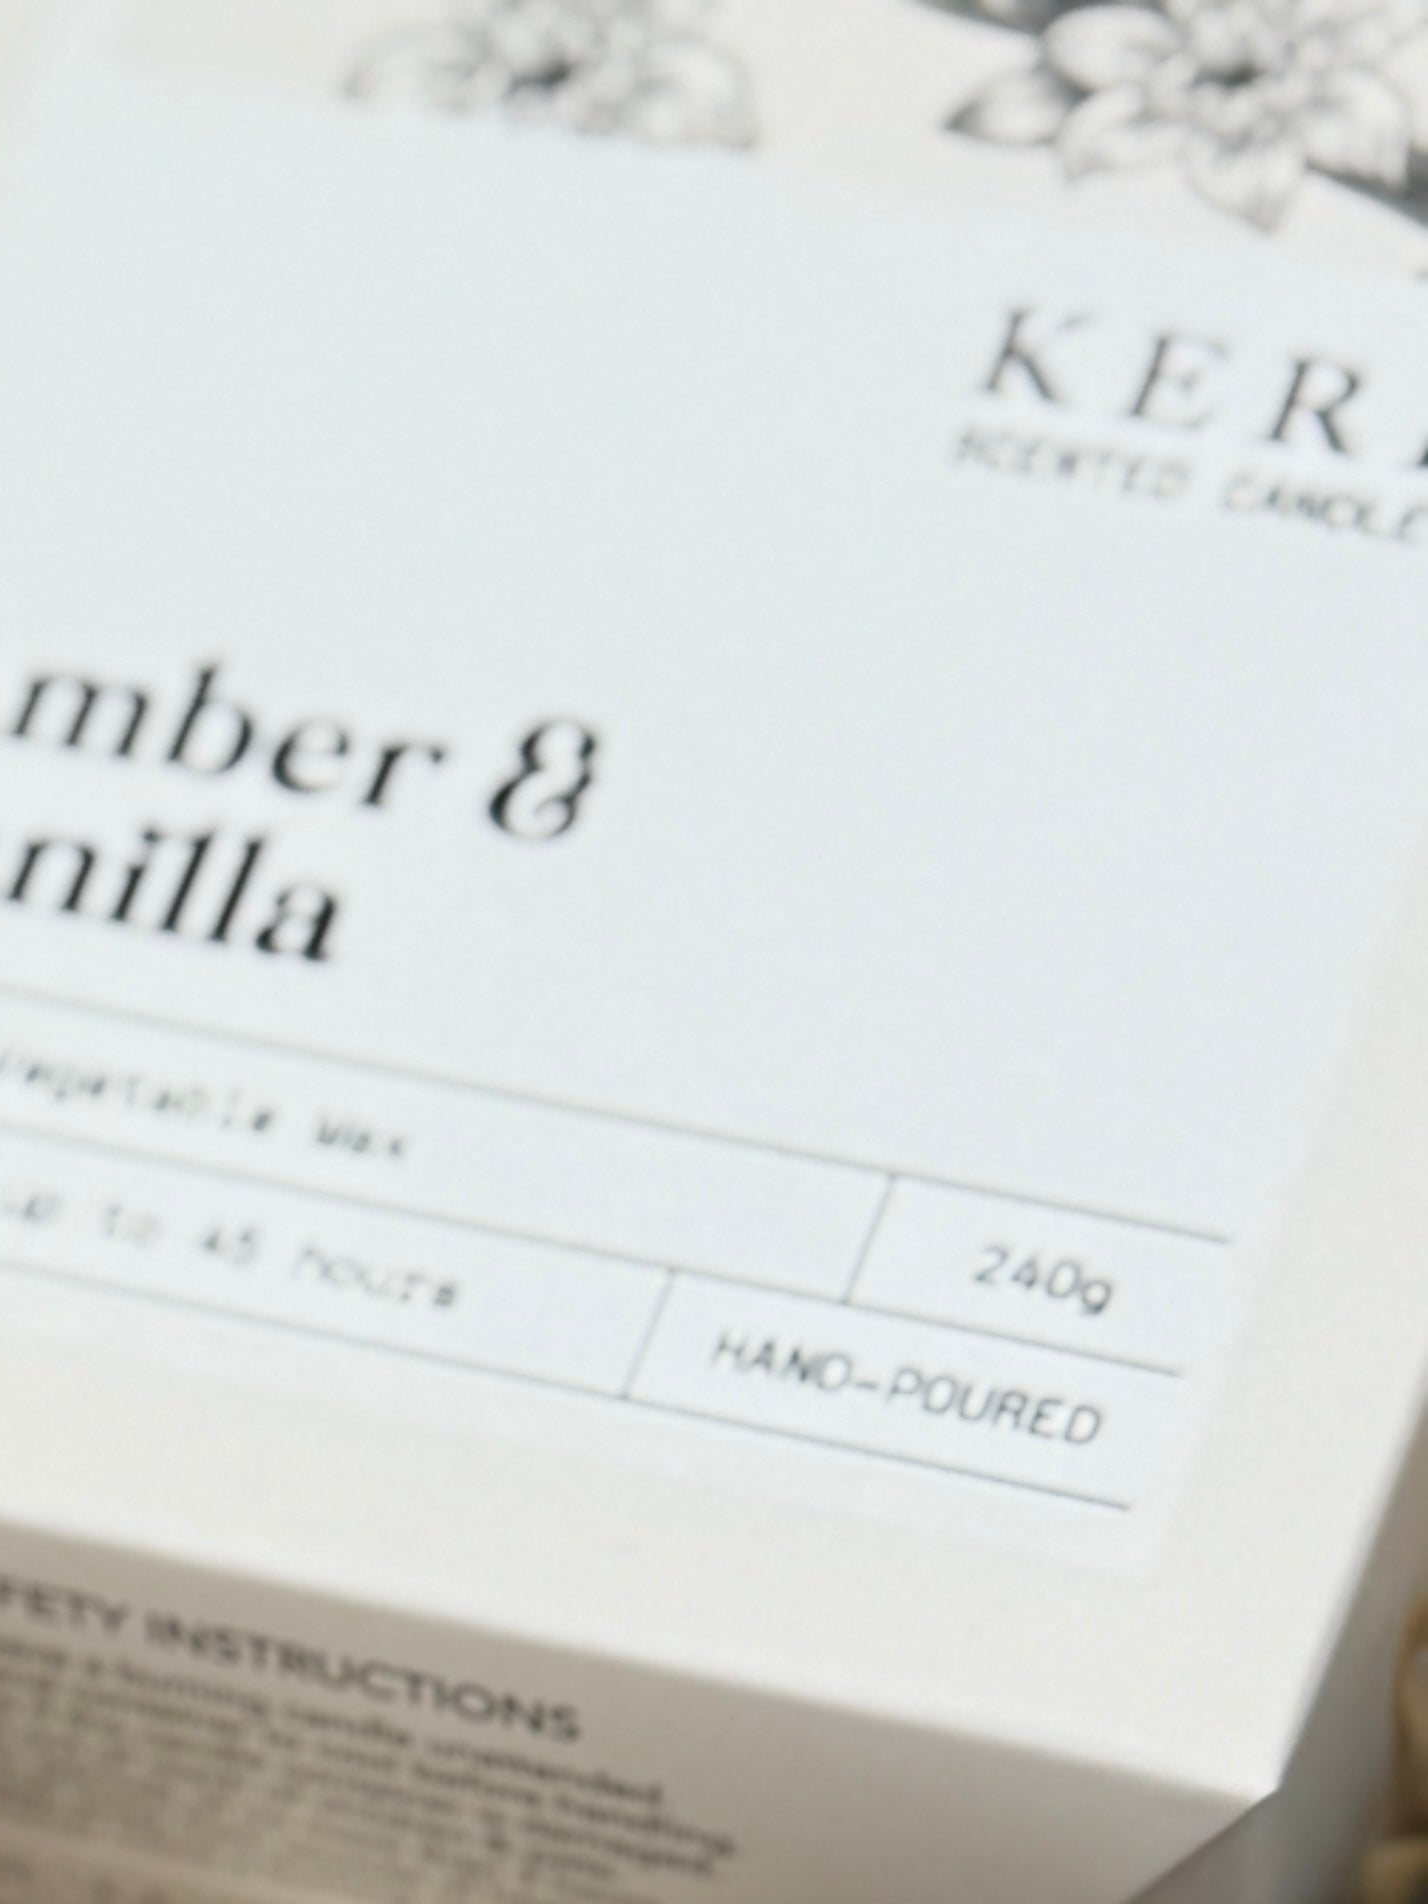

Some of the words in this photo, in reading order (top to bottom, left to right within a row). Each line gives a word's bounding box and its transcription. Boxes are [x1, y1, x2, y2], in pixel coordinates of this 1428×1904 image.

[976, 302, 1428, 468] KER
[486, 714, 600, 842] &
[290, 1234, 460, 1310] hours
[972, 1242, 1116, 1318] 240g
[710, 1330, 1106, 1446] HAND-POURED
[144, 1610, 582, 1746] INSTRUCTIONS
